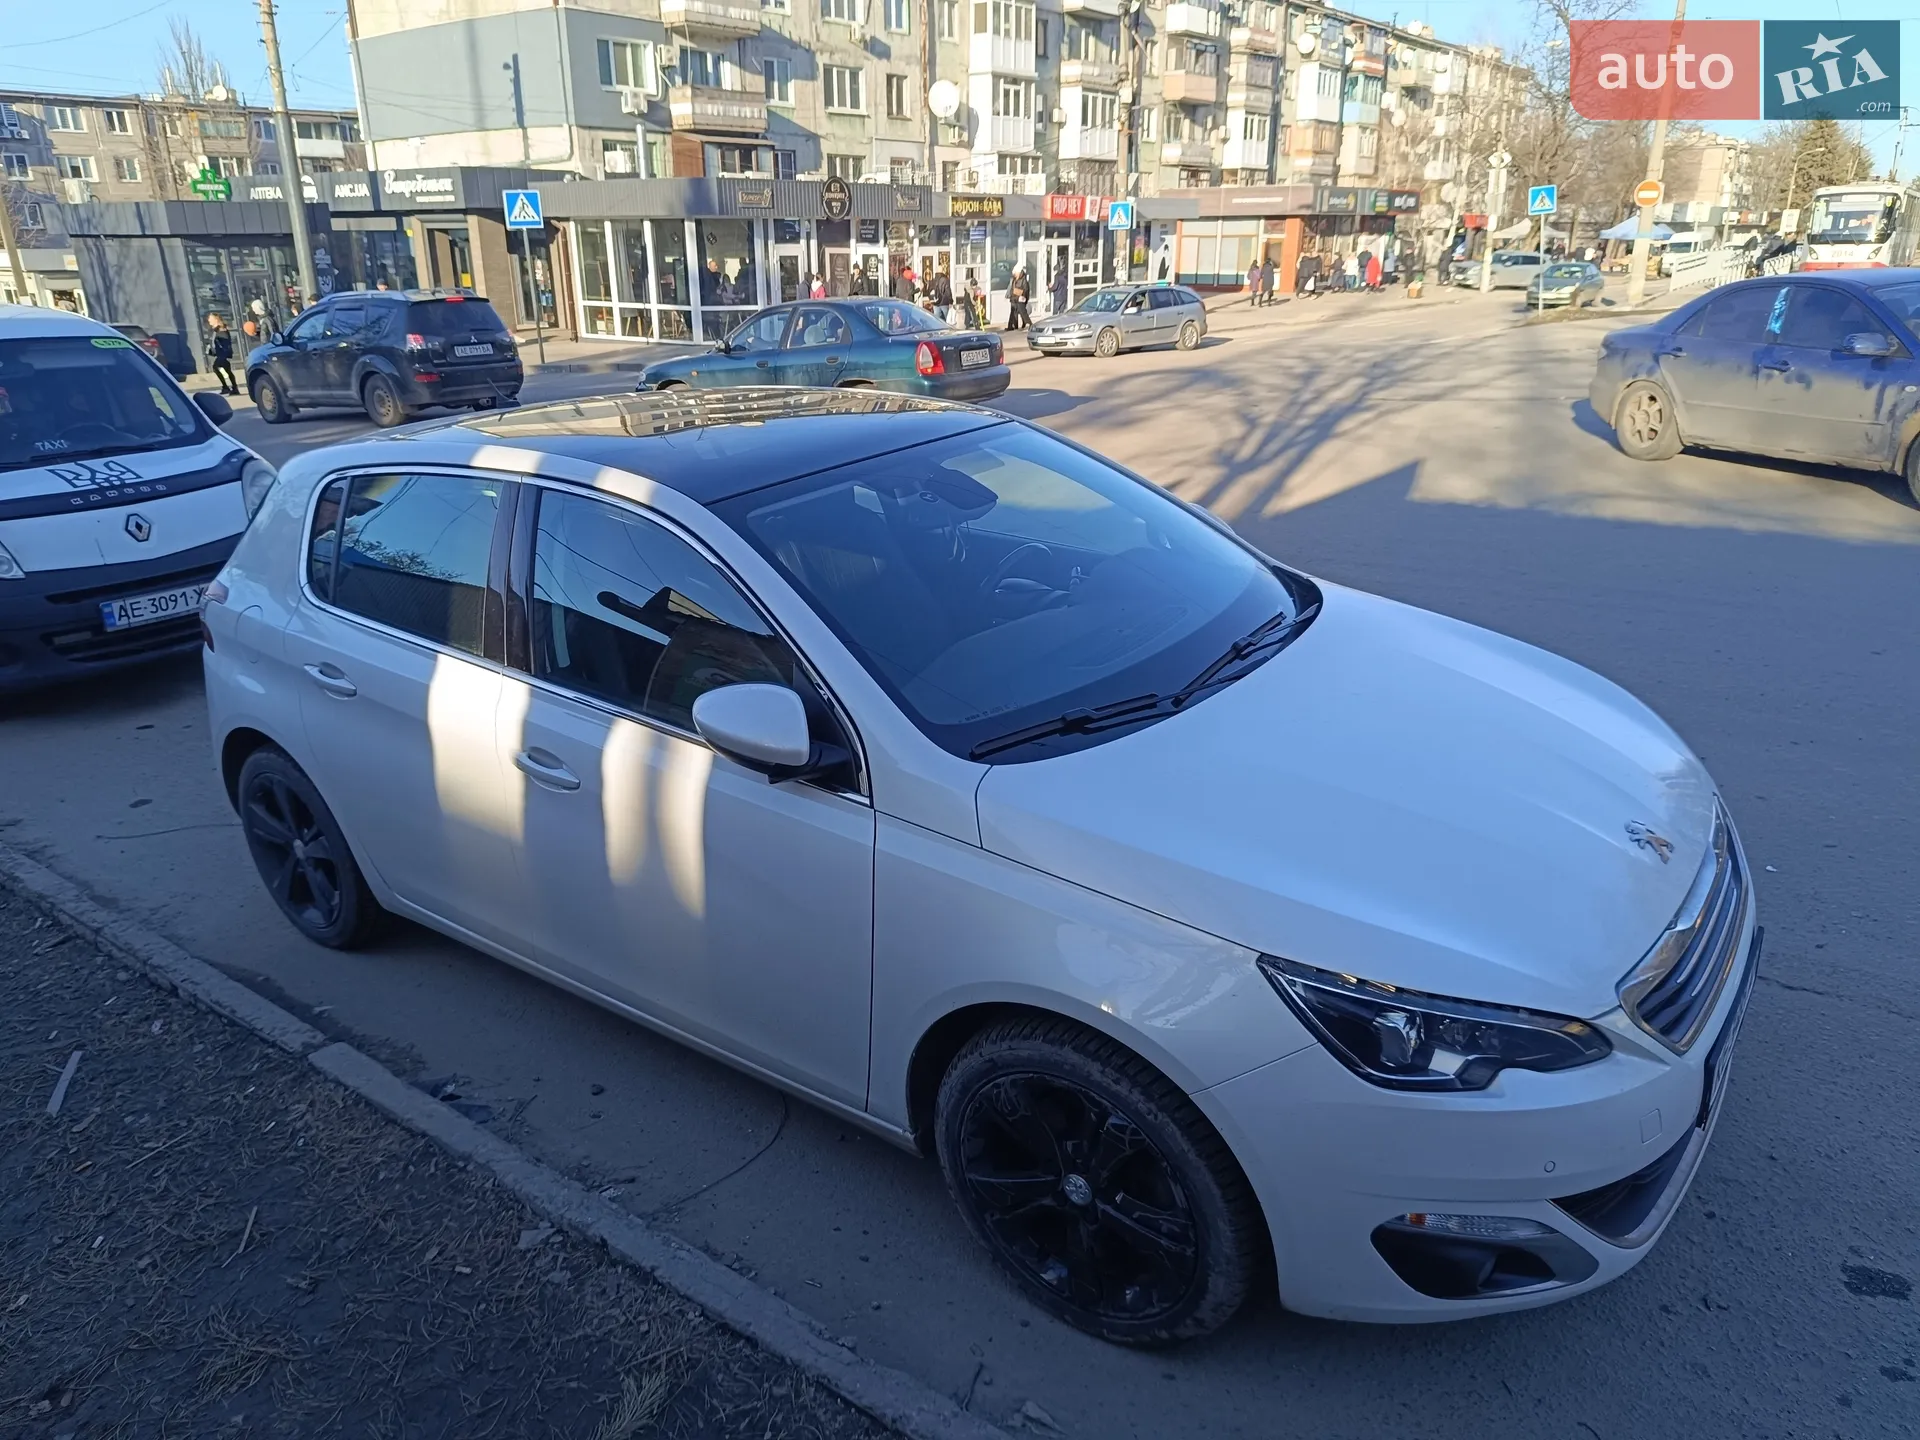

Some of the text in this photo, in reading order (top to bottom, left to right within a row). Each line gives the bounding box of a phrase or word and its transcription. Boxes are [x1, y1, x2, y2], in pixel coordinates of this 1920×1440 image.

[250, 186, 284, 200] АПТЕКА
[1053, 198, 1068, 214] HOP
[1068, 198, 1083, 215] HEY
[35, 439, 68, 451] TAXI
[70, 484, 167, 505] KANGOO
